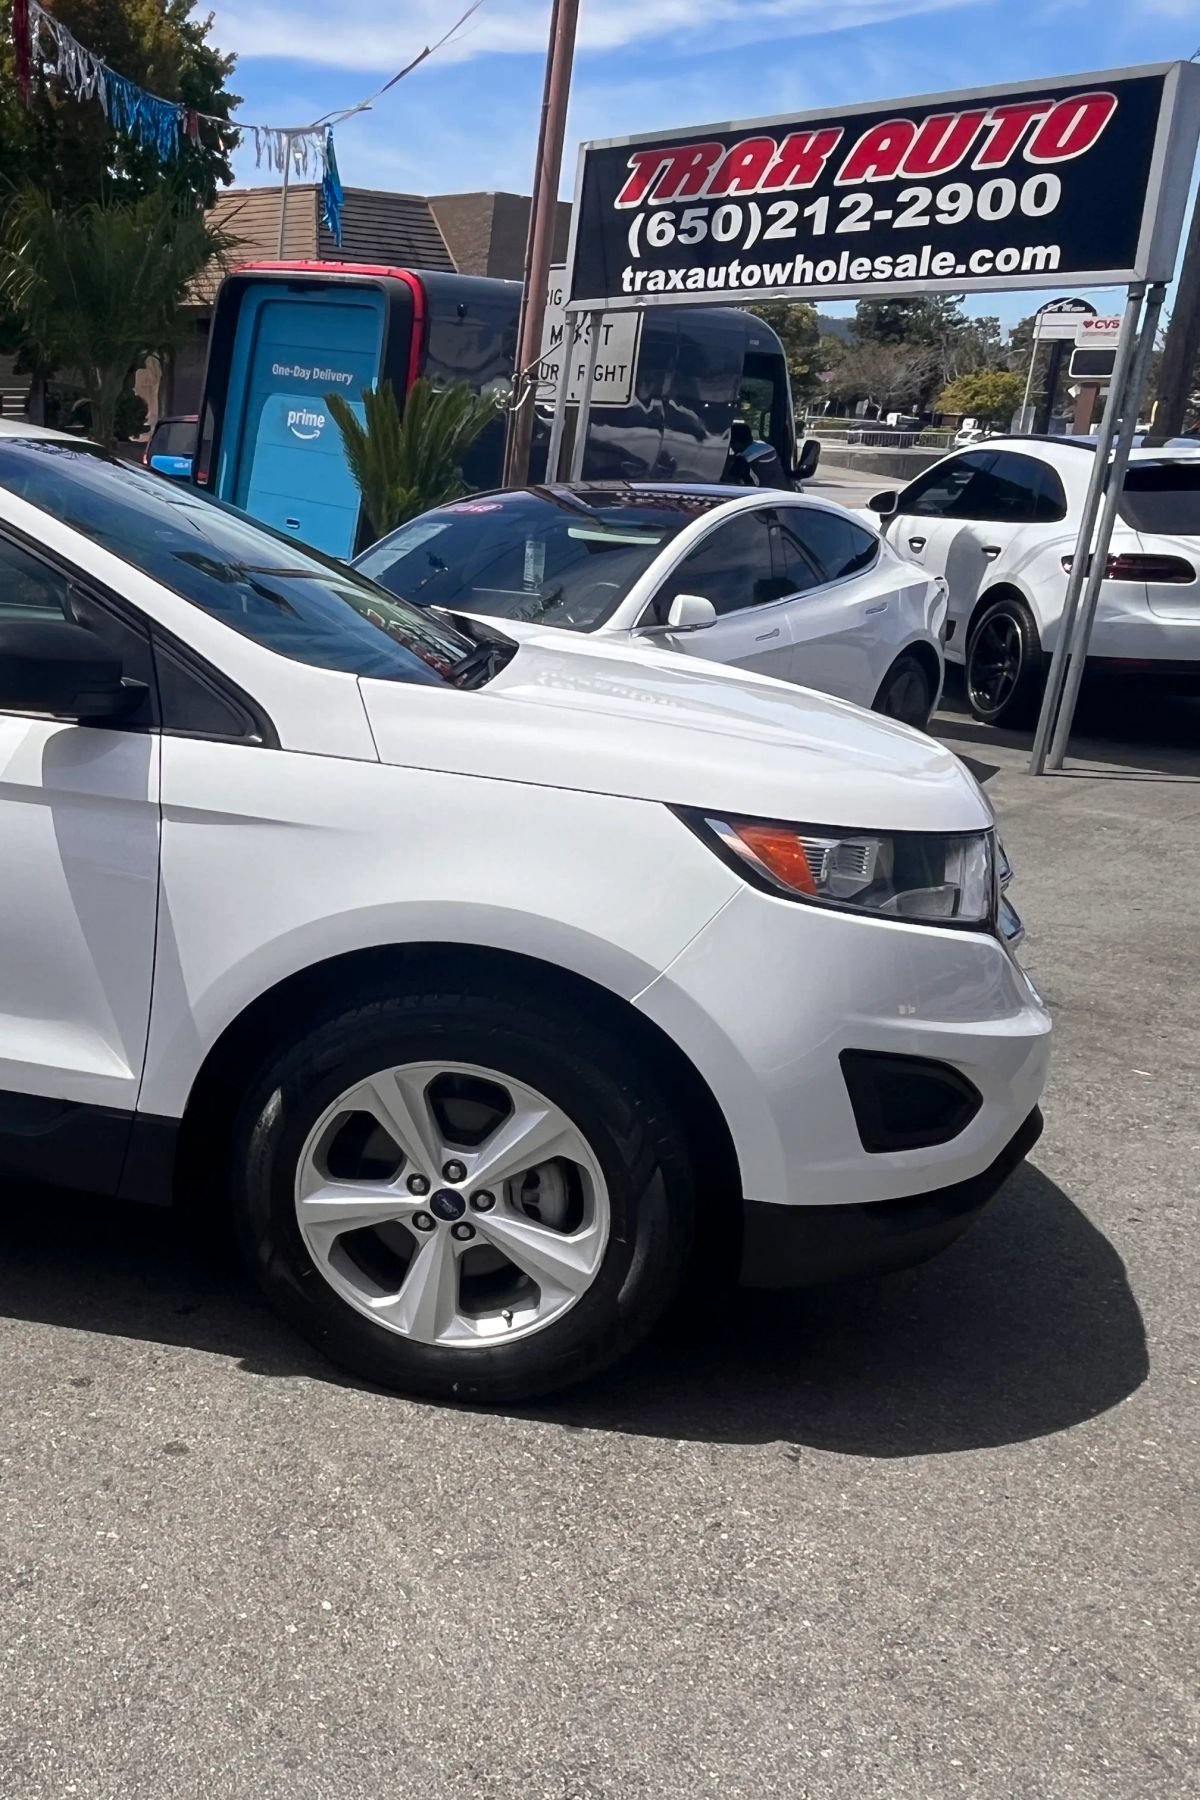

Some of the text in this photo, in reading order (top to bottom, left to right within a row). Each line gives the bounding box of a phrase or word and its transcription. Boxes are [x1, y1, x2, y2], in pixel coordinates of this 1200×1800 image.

[614, 91, 1119, 209] TRAX AUTO
[627, 173, 1063, 257] (650)212-2900
[621, 244, 1062, 293] traxautowholesale.com
[1094, 319, 1120, 329] CVS
[272, 363, 353, 385] One-Day Delivery
[577, 364, 627, 382] RGHT
[287, 408, 325, 428] prime
